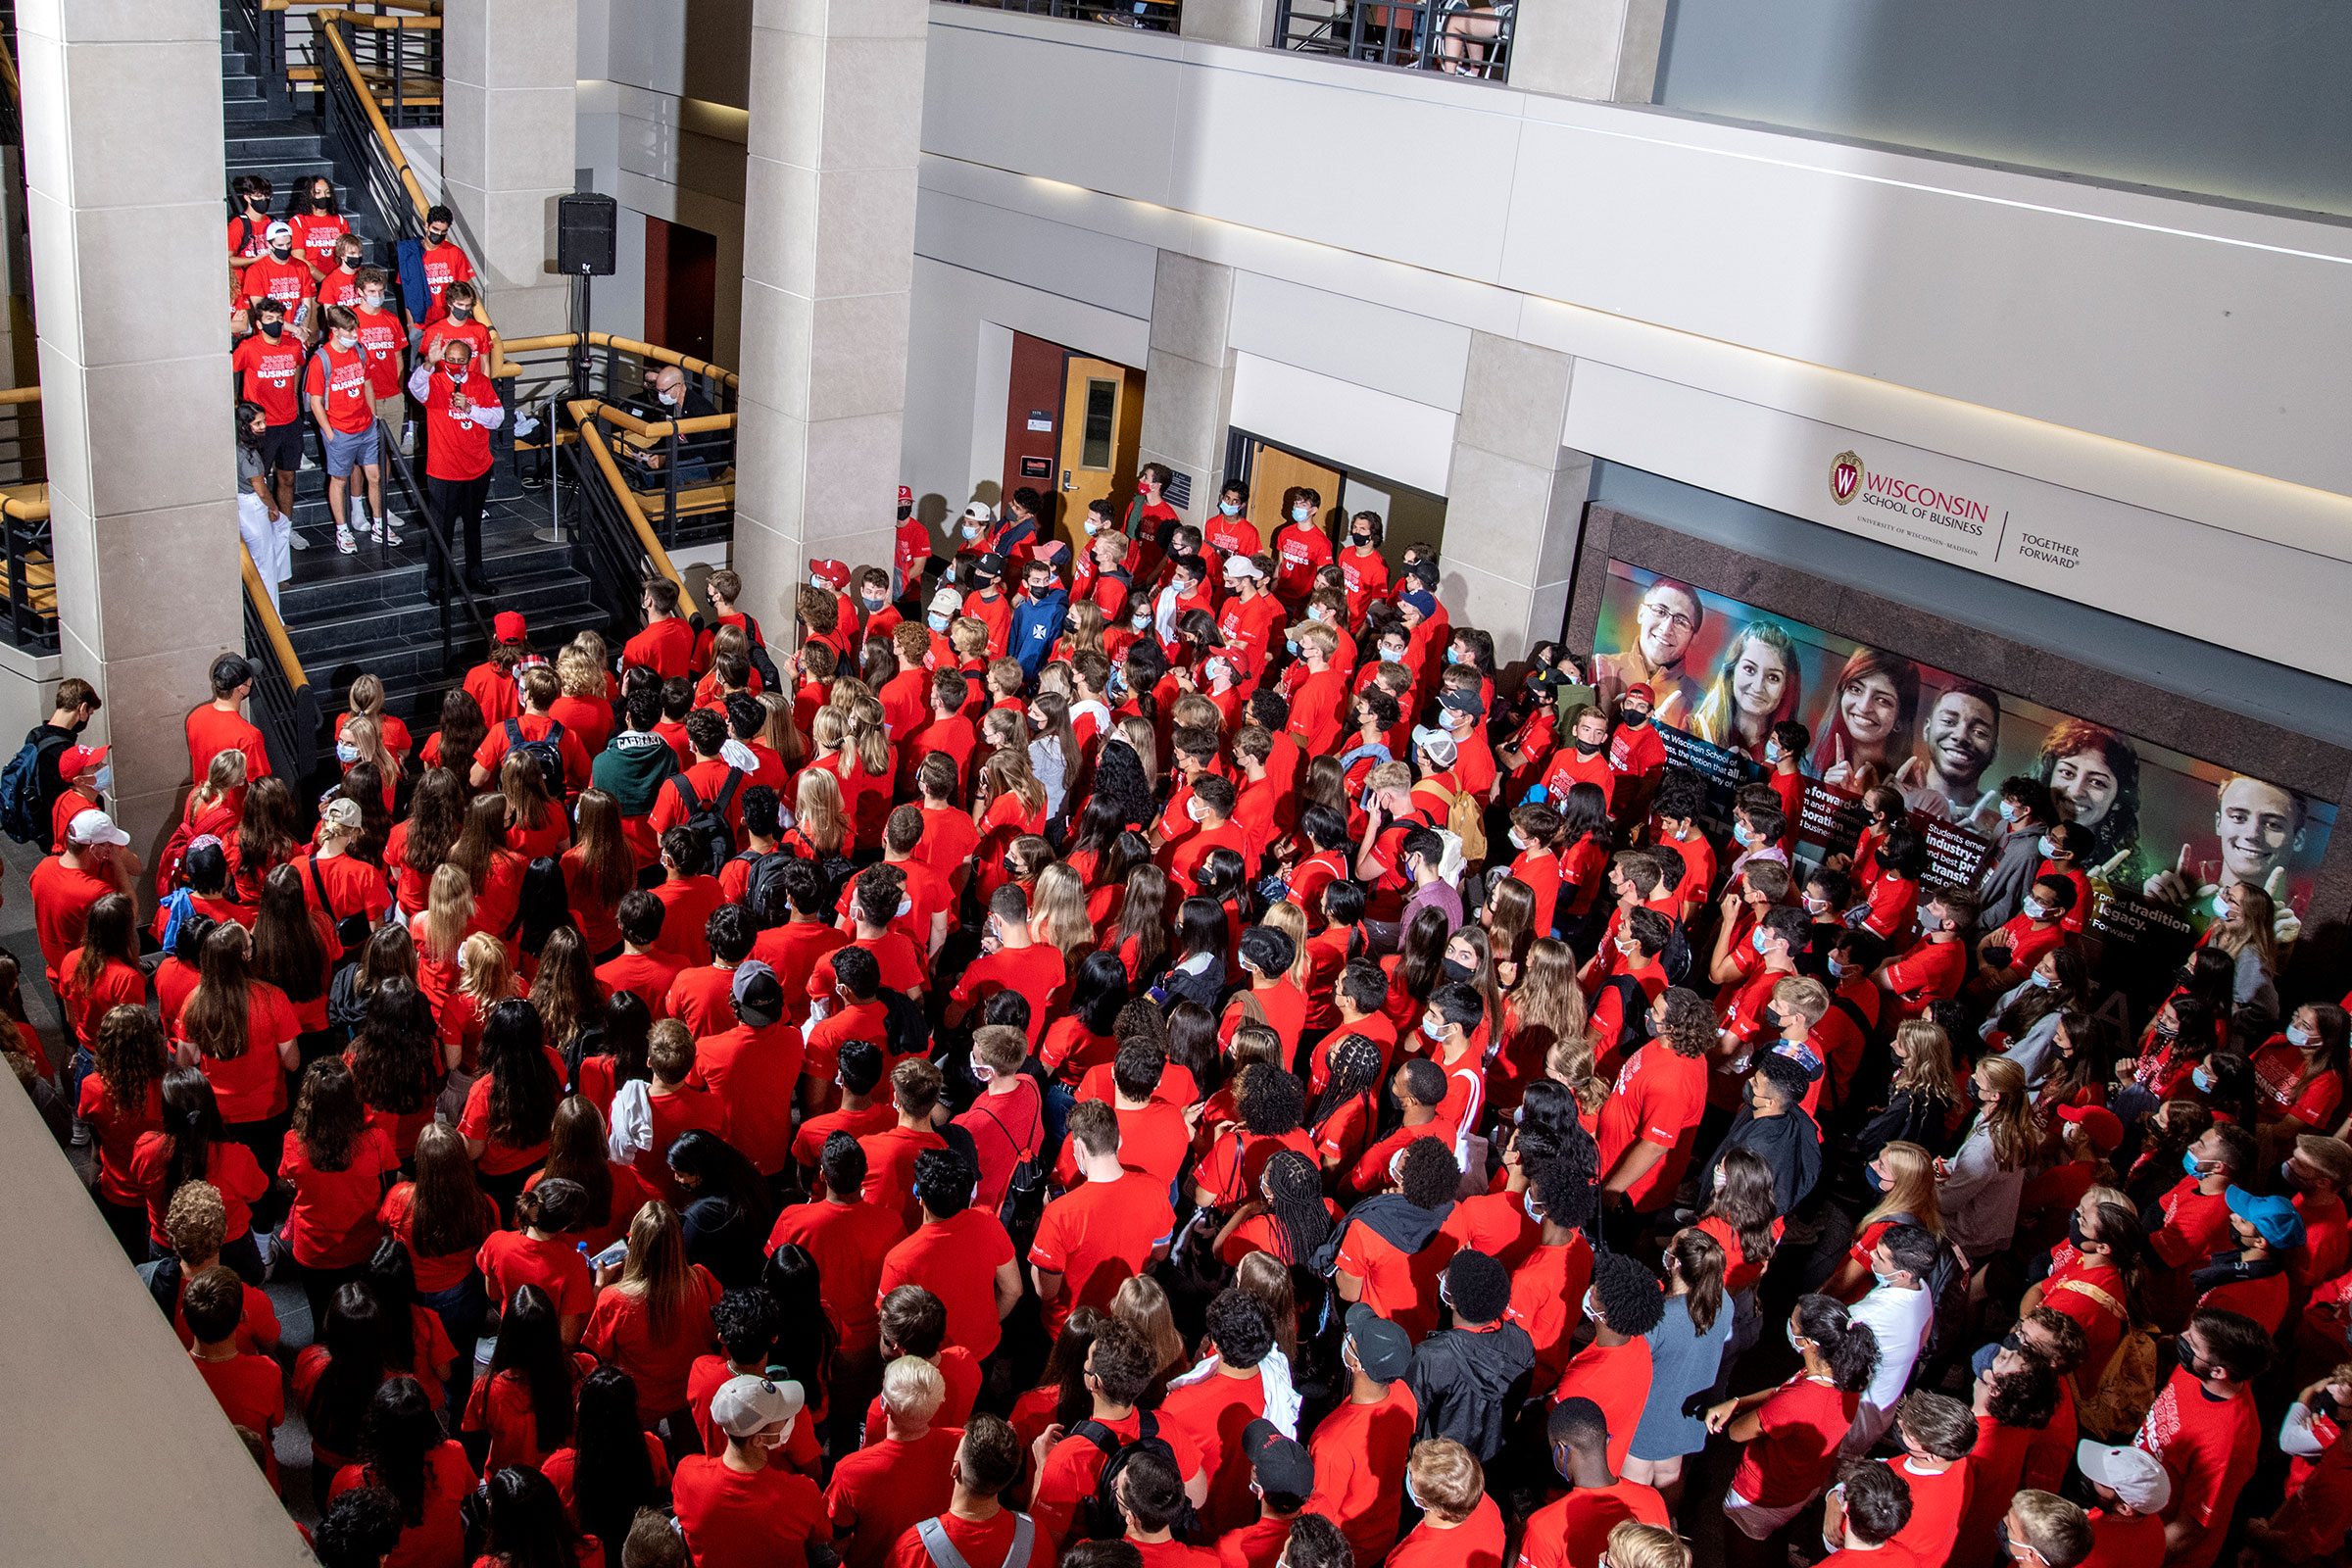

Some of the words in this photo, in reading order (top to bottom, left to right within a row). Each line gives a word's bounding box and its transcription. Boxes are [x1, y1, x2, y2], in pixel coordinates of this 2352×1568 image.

[1838, 467, 1857, 495] W
[1867, 471, 1989, 524] WISCONSIN
[1857, 515, 1895, 532] UNIVERSITY
[1862, 492, 1908, 514] SCHOOL
[1912, 507, 1929, 519] OF
[1930, 512, 1984, 536] BUSINESS
[2022, 532, 2080, 558] TOGETHER
[1658, 730, 1670, 741] the
[1671, 735, 1705, 755] Wisconsin
[1705, 748, 1729, 764] School
[1678, 749, 1690, 760] the
[1690, 756, 1712, 768] notion
[1712, 763, 1727, 775] that
[1727, 766, 1740, 780] all
[1711, 774, 1724, 786] any
[1810, 801, 1825, 811] and
[1928, 823, 1964, 845] Students
[1939, 854, 1958, 868] best
[2098, 893, 2128, 909] proud
[2129, 901, 2192, 934] tradition
[2098, 902, 2147, 932] legacy.
[2092, 918, 2136, 944] Forward.
